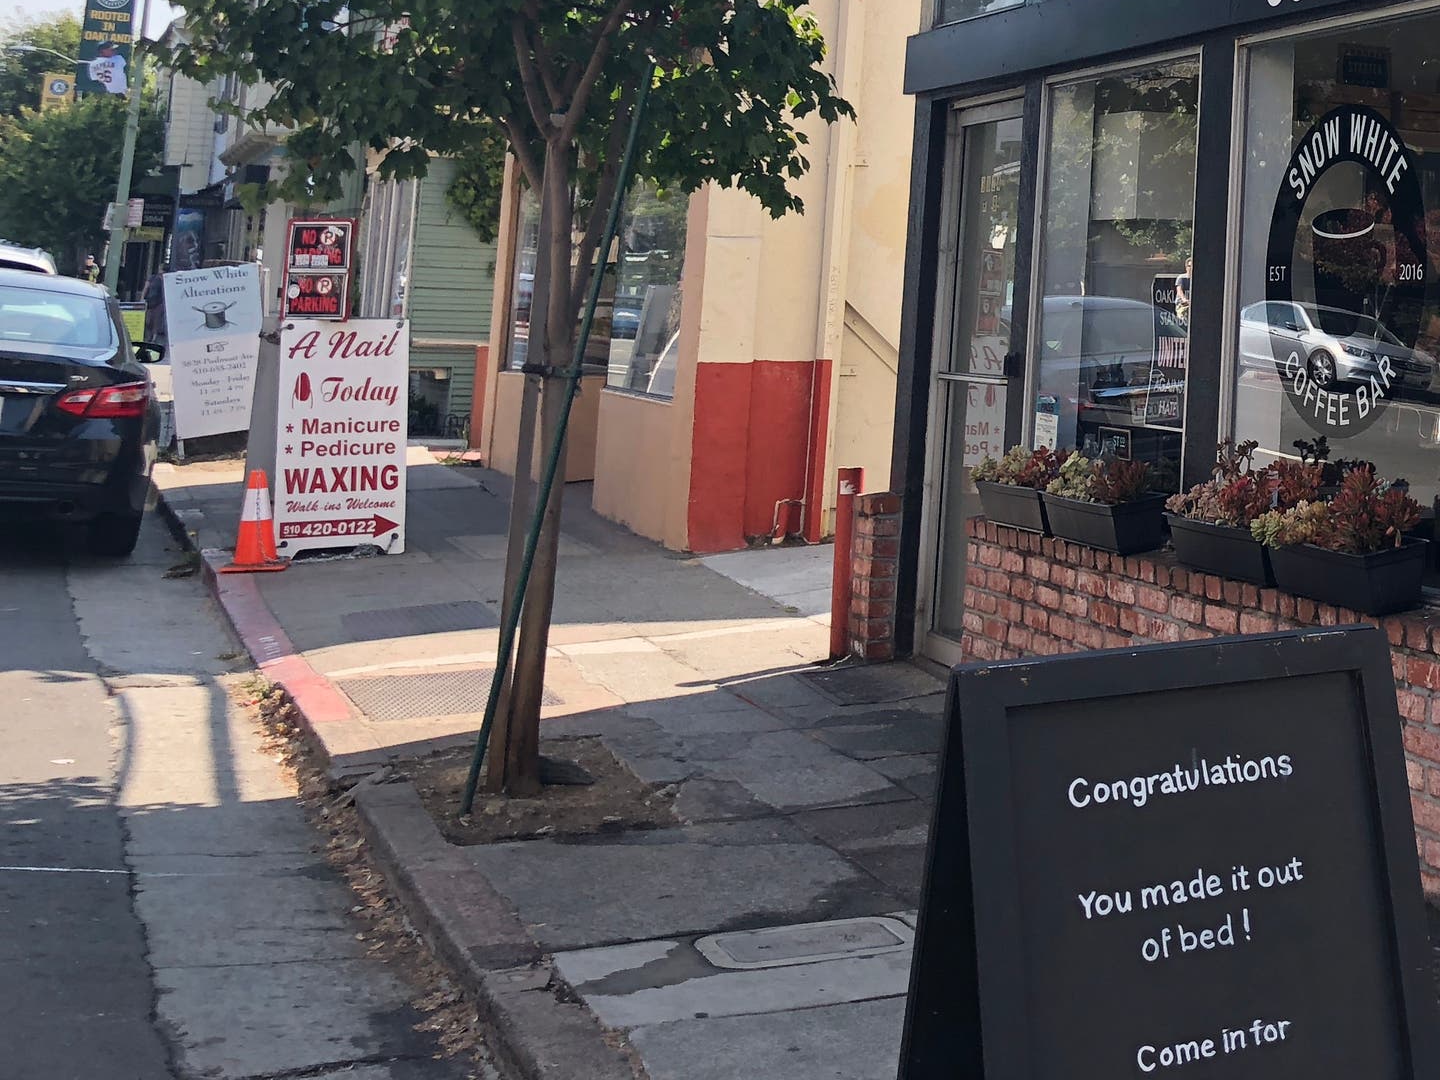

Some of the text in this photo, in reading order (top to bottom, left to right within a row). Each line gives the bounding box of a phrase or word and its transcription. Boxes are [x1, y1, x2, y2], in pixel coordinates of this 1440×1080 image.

[91, 10, 130, 21] ROOTED
[102, 22, 115, 31] IN
[1289, 114, 1409, 200] SNOW WHITE
[302, 229, 317, 245] NO
[175, 269, 249, 285] Snow White
[1269, 266, 1286, 281] EST
[1399, 263, 1423, 281] 2016
[181, 285, 246, 299] Alterations
[298, 277, 313, 293] NO
[291, 297, 337, 312] PARKING
[288, 330, 400, 359] A Nail
[320, 376, 399, 406] Today
[1285, 350, 1397, 426] COFFEE BAR
[301, 418, 400, 435] Manicure
[301, 440, 396, 457] Pedicure
[284, 464, 399, 494] WAXING
[346, 498, 396, 510] Welcome
[283, 520, 376, 535] 510 420-0122
[1067, 751, 1293, 808] Congratulations
[1078, 857, 1304, 919] You made it out
[1141, 928, 1171, 962] of
[1137, 1019, 1292, 1073] Come in for
